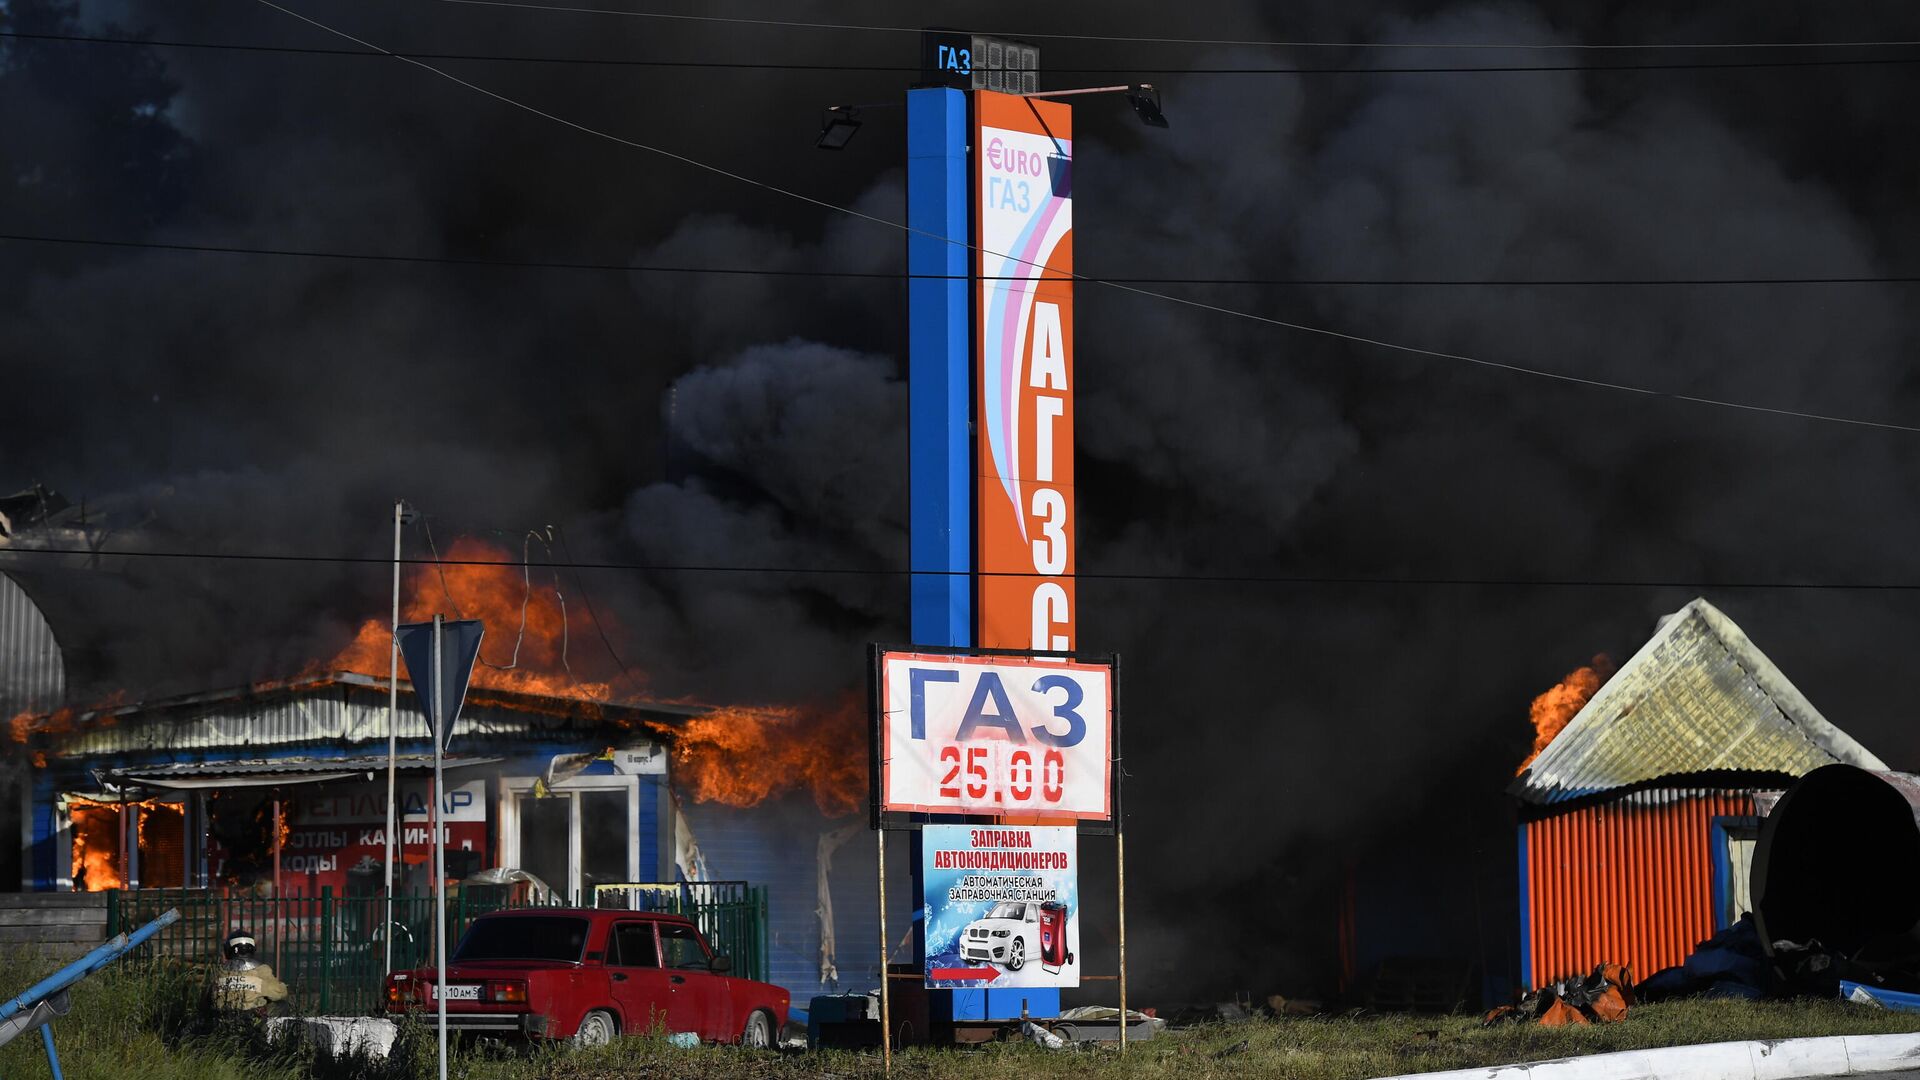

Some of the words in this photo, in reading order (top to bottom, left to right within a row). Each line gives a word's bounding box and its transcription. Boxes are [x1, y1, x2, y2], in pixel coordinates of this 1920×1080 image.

[938, 45, 971, 75] ГАЗ
[989, 176, 1031, 213] ГАЗ
[1029, 301, 1069, 661] АГЗС
[908, 667, 1086, 748] ГАЗ
[940, 746, 1064, 802] 25.00
[290, 830, 348, 849] ОТЛЫ
[359, 827, 450, 846] КАИНЫ
[971, 830, 1032, 848] ЗАПРАВКА
[935, 851, 1068, 871] АВТОКОНДИЦИОНЕРОВ
[963, 876, 1043, 888] АВТОМАТИЧЕСКАЯ
[949, 889, 1013, 900] ЗАПРАВОЧНАЯ
[1015, 890, 1056, 902] СТАНЦИЯ
